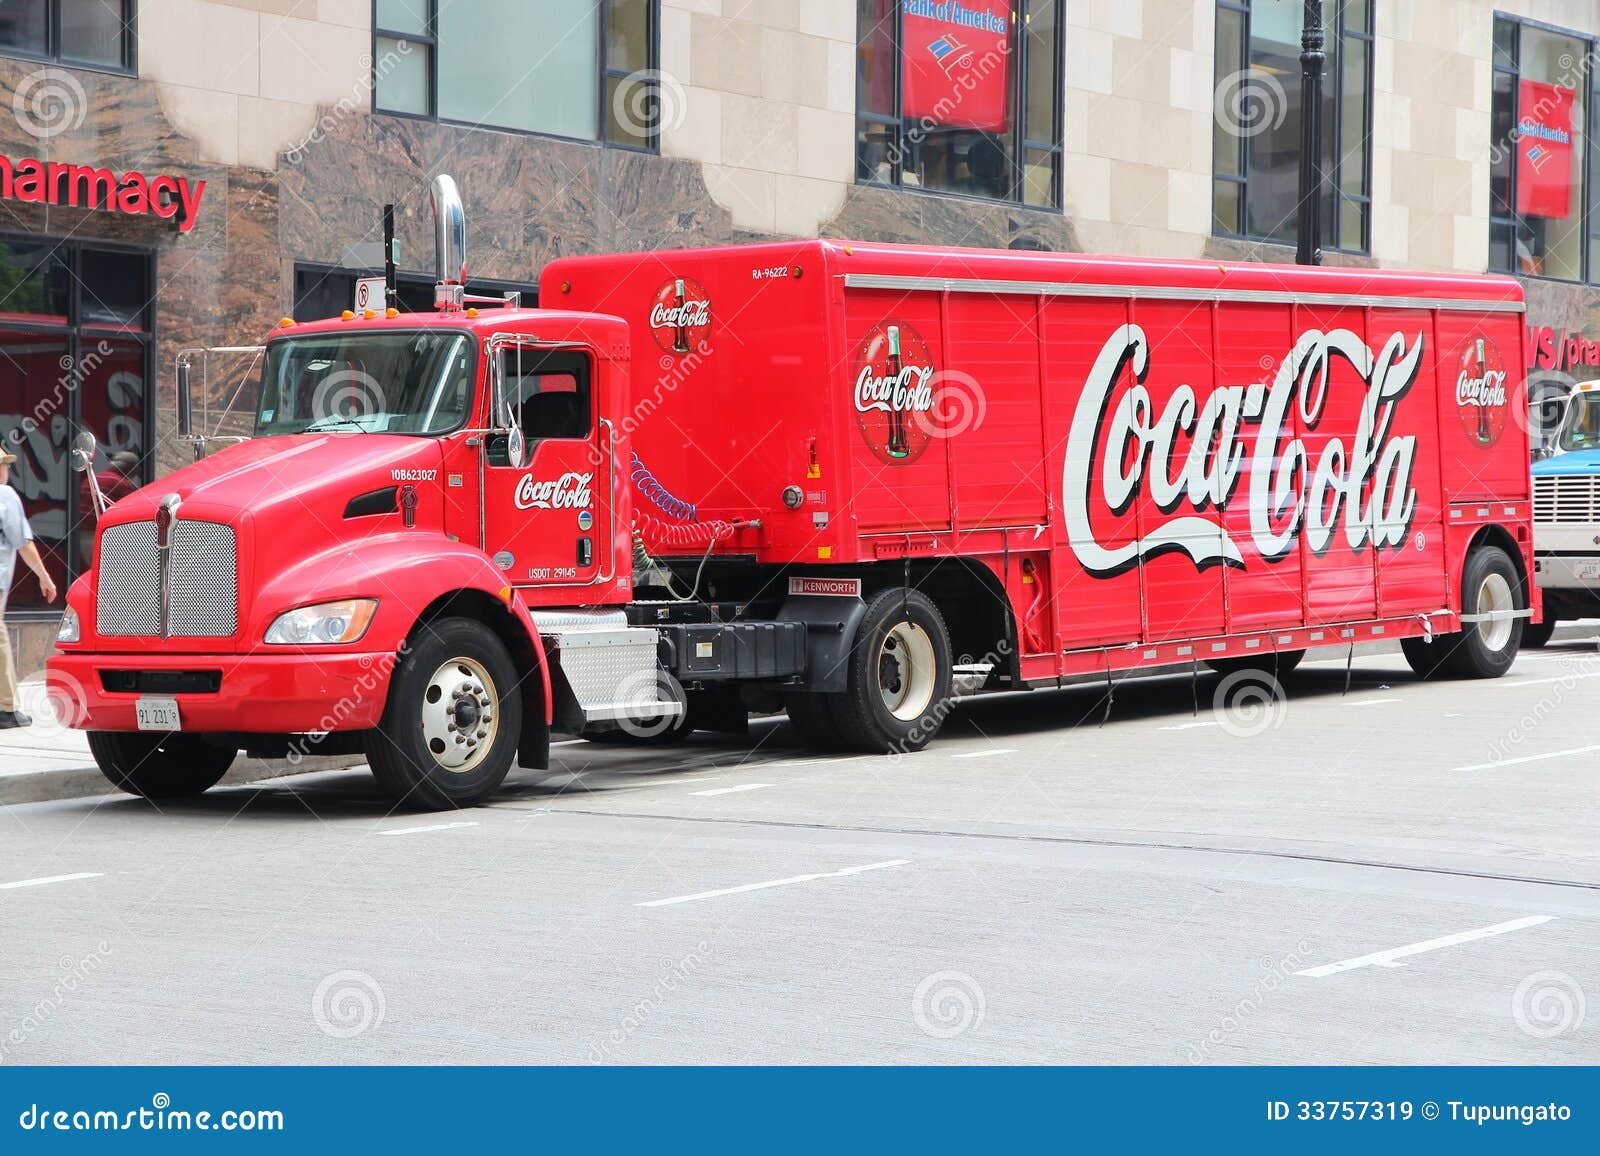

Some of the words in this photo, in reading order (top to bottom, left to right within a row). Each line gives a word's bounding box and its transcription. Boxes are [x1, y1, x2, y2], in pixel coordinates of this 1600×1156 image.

[936, 0, 951, 22] of
[951, 2, 1006, 35] America
[752, 266, 788, 279] RA-96222
[650, 299, 710, 328] Coca-Cola
[854, 365, 934, 412] Coca-Cola
[1456, 369, 1507, 406] Coca-Cola
[1063, 323, 1424, 578] Coca-Cola
[514, 472, 594, 509] Coca-Cola
[528, 568, 550, 579] USDOT
[804, 581, 856, 593] KENWORTH
[138, 709, 150, 724] 91
